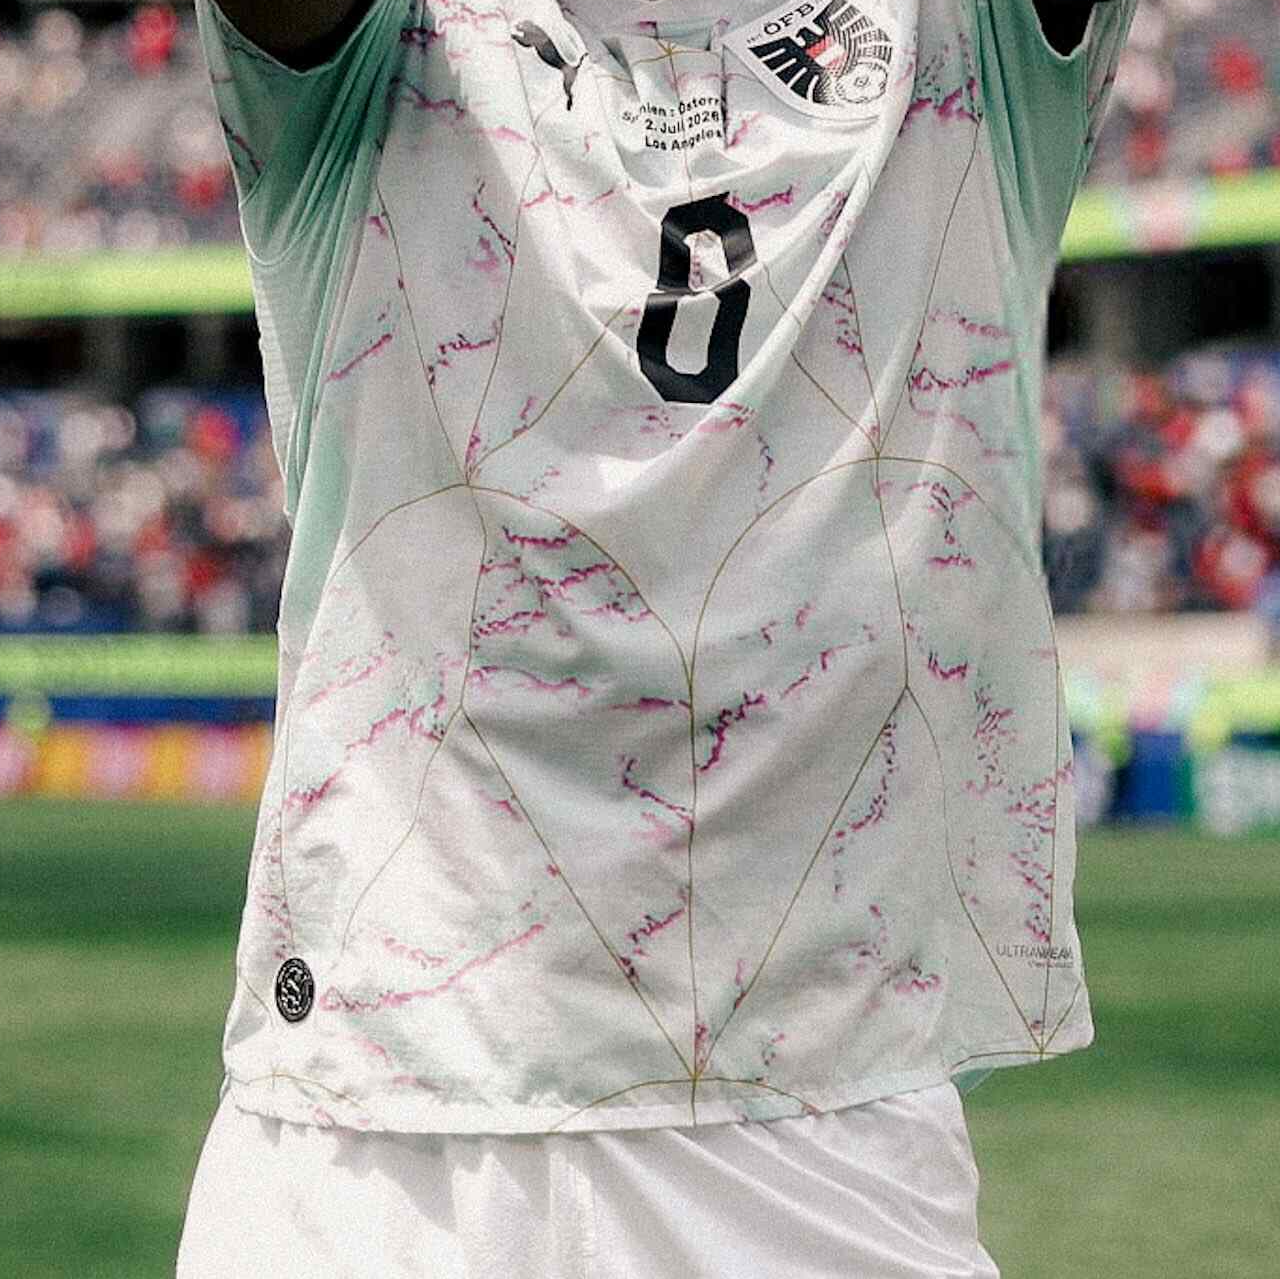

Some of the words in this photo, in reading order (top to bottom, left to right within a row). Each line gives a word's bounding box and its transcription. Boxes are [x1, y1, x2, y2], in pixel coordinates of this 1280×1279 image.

[764, 3, 815, 35] ÖFB
[645, 118, 658, 131] 2.
[645, 136, 667, 150] Los
[671, 129, 722, 151] Angeles
